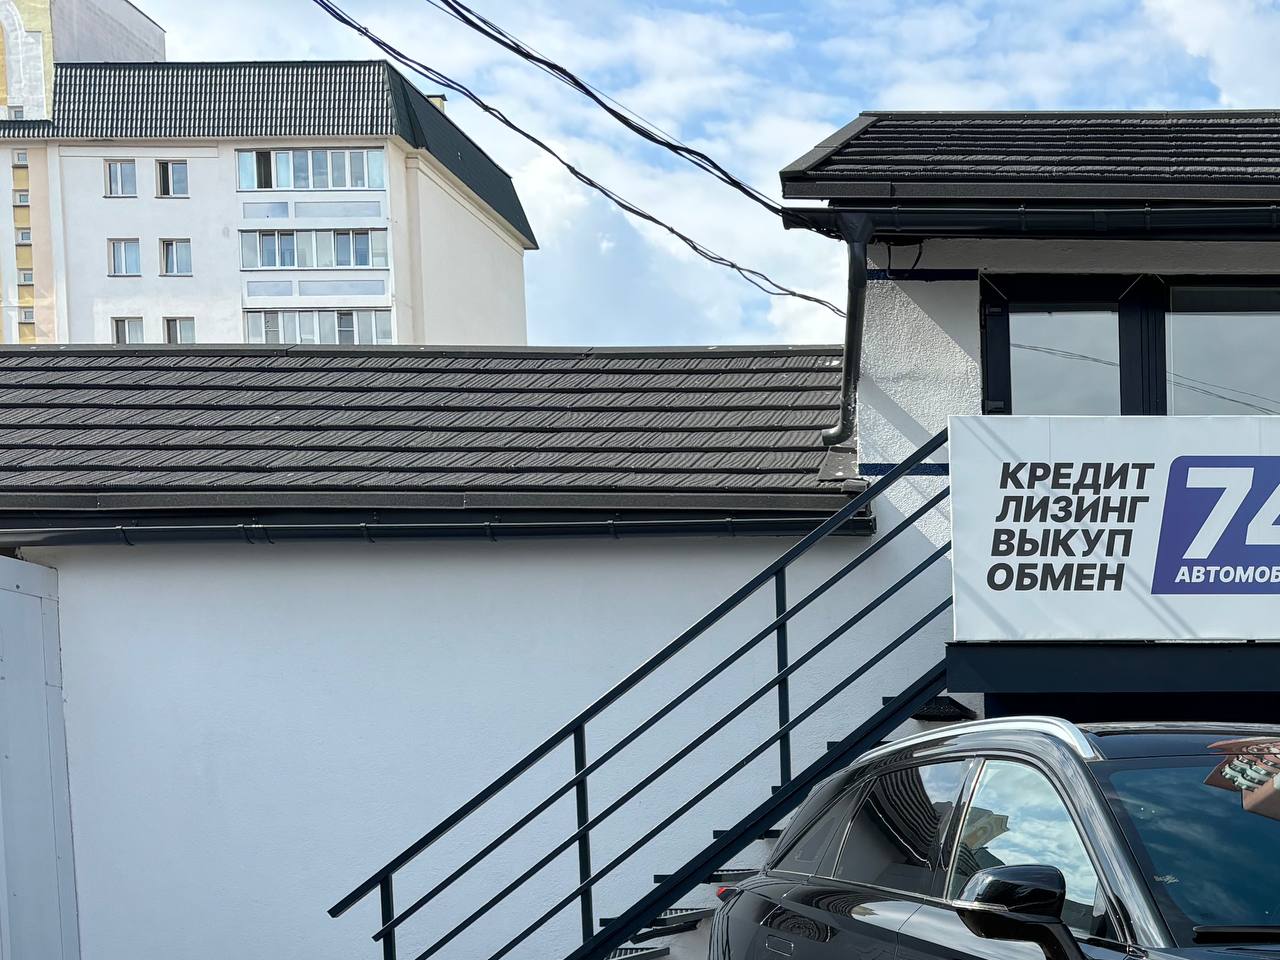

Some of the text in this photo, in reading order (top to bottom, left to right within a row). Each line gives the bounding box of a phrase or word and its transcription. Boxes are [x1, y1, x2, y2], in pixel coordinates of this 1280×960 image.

[1000, 462, 1155, 495] КРЕДИТ
[995, 495, 1149, 523] ЛИЗИНГ
[991, 528, 1133, 557] ВЫКУП
[987, 562, 1125, 591] ОБМЕН
